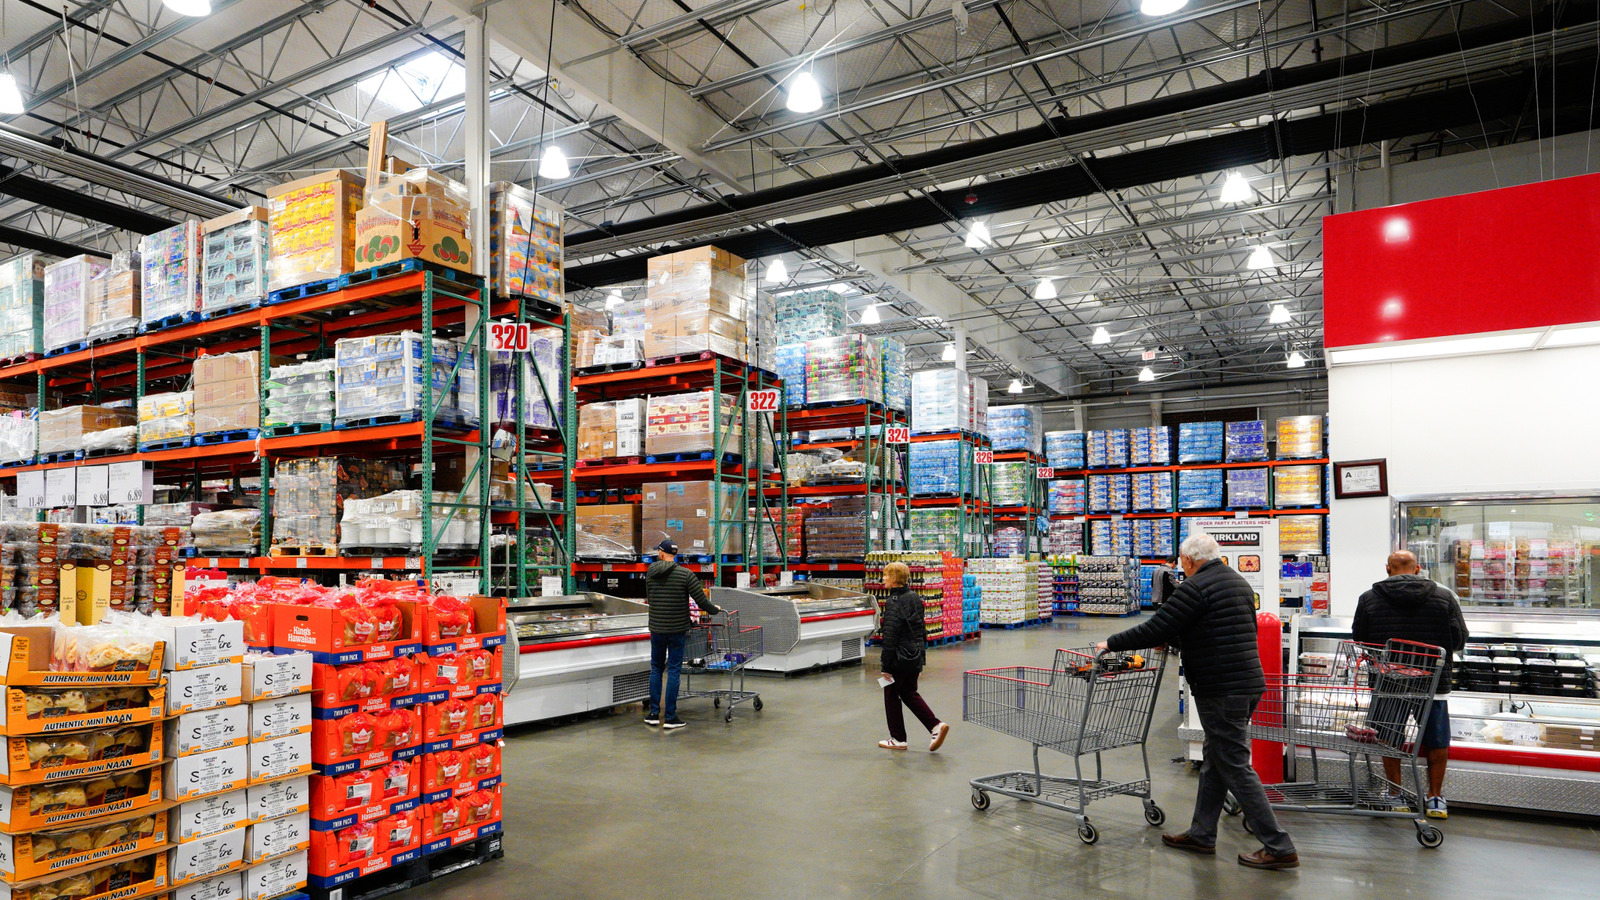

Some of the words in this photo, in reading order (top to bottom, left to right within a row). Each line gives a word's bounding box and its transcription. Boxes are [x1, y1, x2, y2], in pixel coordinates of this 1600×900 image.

[491, 324, 528, 350] 320
[750, 392, 776, 410] 322
[888, 429, 909, 442] 324
[976, 452, 992, 463] 326
[1038, 468, 1053, 477] 328
[62, 494, 75, 505] 9.99
[93, 493, 108, 505] 8.89
[127, 489, 142, 501] 6.89
[29, 496, 44, 507] 11.49
[293, 626, 312, 637] King's
[288, 633, 316, 645] Hawaiian
[366, 650, 390, 659] Hawaiian
[408, 646, 416, 654] PACK
[340, 654, 348, 662] TWIN
[349, 654, 358, 662] PACK
[43, 675, 84, 683] AUTHENTIC
[105, 674, 132, 682] NAAN
[367, 698, 382, 706] King's
[396, 698, 404, 706] TWIN
[44, 719, 84, 731] AUTHENTIC
[86, 718, 104, 726] MINI
[105, 714, 132, 724] NAAN
[440, 742, 448, 750] PACK
[369, 750, 384, 760] King's
[364, 756, 388, 766] Hawaiian
[45, 768, 86, 780] AUTHENTIC
[87, 764, 104, 773] MINI
[106, 759, 132, 770] NAAN
[336, 764, 345, 772] TWIN
[46, 812, 86, 824] AUTHENTIC
[88, 808, 105, 816] MINI
[107, 800, 132, 812] NAAN
[366, 804, 382, 814] King's
[362, 809, 386, 821] Hawaiian
[333, 820, 342, 828] TWIN
[343, 818, 352, 826] PACK
[438, 840, 447, 848] PACK
[50, 856, 90, 870] AUTHENTIC
[92, 850, 110, 860] MINI
[111, 842, 137, 854] NAAN
[405, 852, 414, 860] PACK
[368, 857, 384, 867] King's
[363, 862, 388, 874] Hawaiian
[335, 875, 344, 884] TWIN
[344, 872, 354, 880] PACK
[111, 888, 137, 899] NAAN
